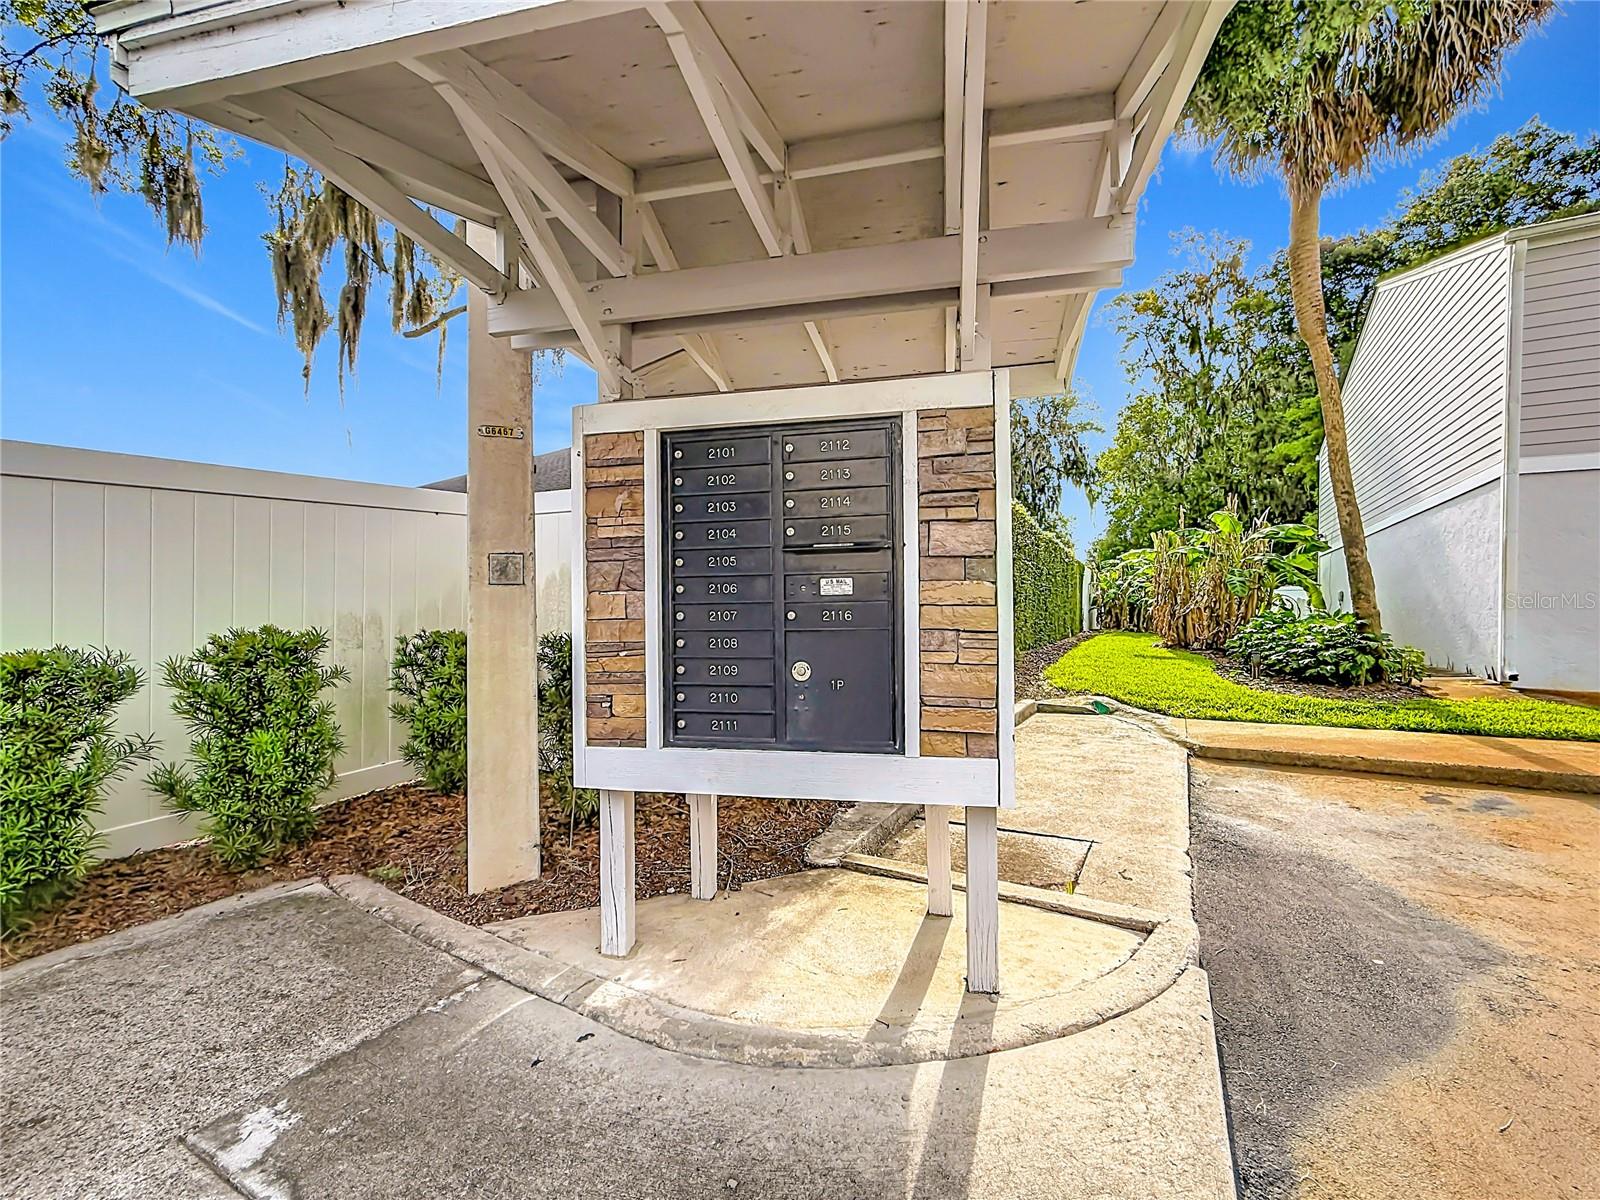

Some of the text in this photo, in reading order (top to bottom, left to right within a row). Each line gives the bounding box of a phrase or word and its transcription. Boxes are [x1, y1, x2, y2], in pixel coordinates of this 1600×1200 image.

[820, 440, 850, 451] 2112
[709, 448, 734, 458] 2101
[821, 469, 850, 480] 2113
[708, 475, 735, 485] 2102
[708, 502, 736, 512] 2103
[821, 497, 850, 507] 2114
[709, 529, 736, 539] 2104
[822, 525, 850, 535] 2115
[709, 557, 736, 566] 2105
[709, 584, 737, 593] 2106
[710, 611, 736, 621] 2107
[823, 611, 851, 620] 2116
[710, 639, 737, 648] 2108
[710, 666, 737, 675] 2109
[831, 680, 844, 690] 1P
[710, 693, 737, 703] 2110
[712, 721, 736, 730] 2111
